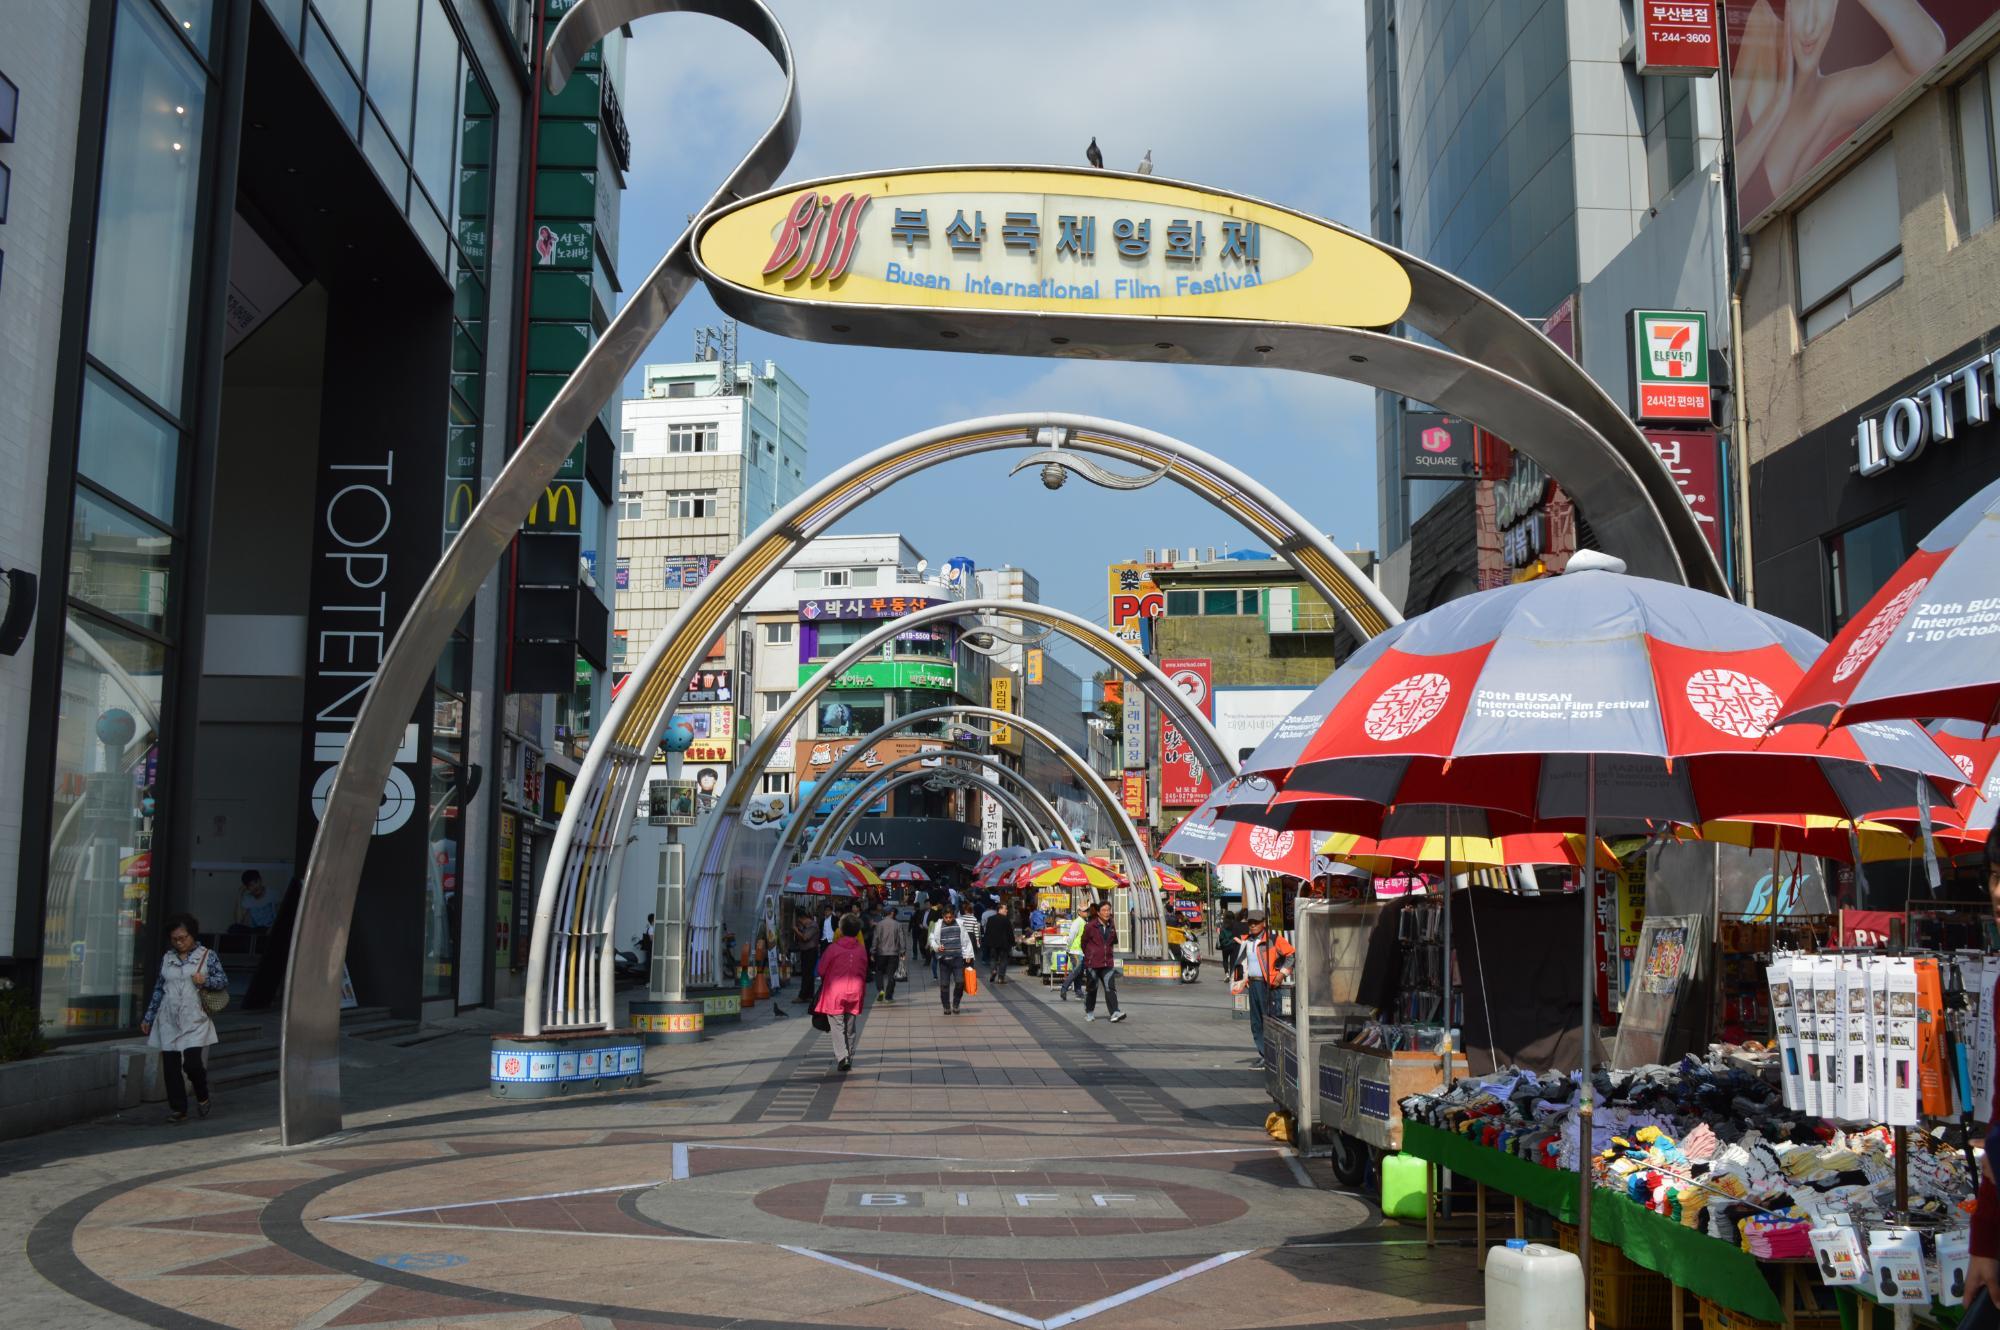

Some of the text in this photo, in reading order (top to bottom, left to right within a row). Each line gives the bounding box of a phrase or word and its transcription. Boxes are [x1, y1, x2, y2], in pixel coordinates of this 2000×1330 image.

[1652, 7, 1708, 23] 부산본점
[1652, 32, 1711, 43] T.244-3600
[890, 208, 1261, 264] 부산국제영화제
[886, 262, 1263, 299] Busan International Film Festival
[1647, 395, 1705, 408] 24시간 편의점
[1415, 456, 1459, 467] SQUARE
[825, 597, 927, 618] 박사 부동산
[1917, 603, 1962, 615] 20th
[1478, 690, 1572, 702] 20th BUSAN
[1476, 699, 1650, 710] International Film Festival
[1571, 710, 1603, 718] 2015
[859, 1193, 1138, 1207] BIFF
